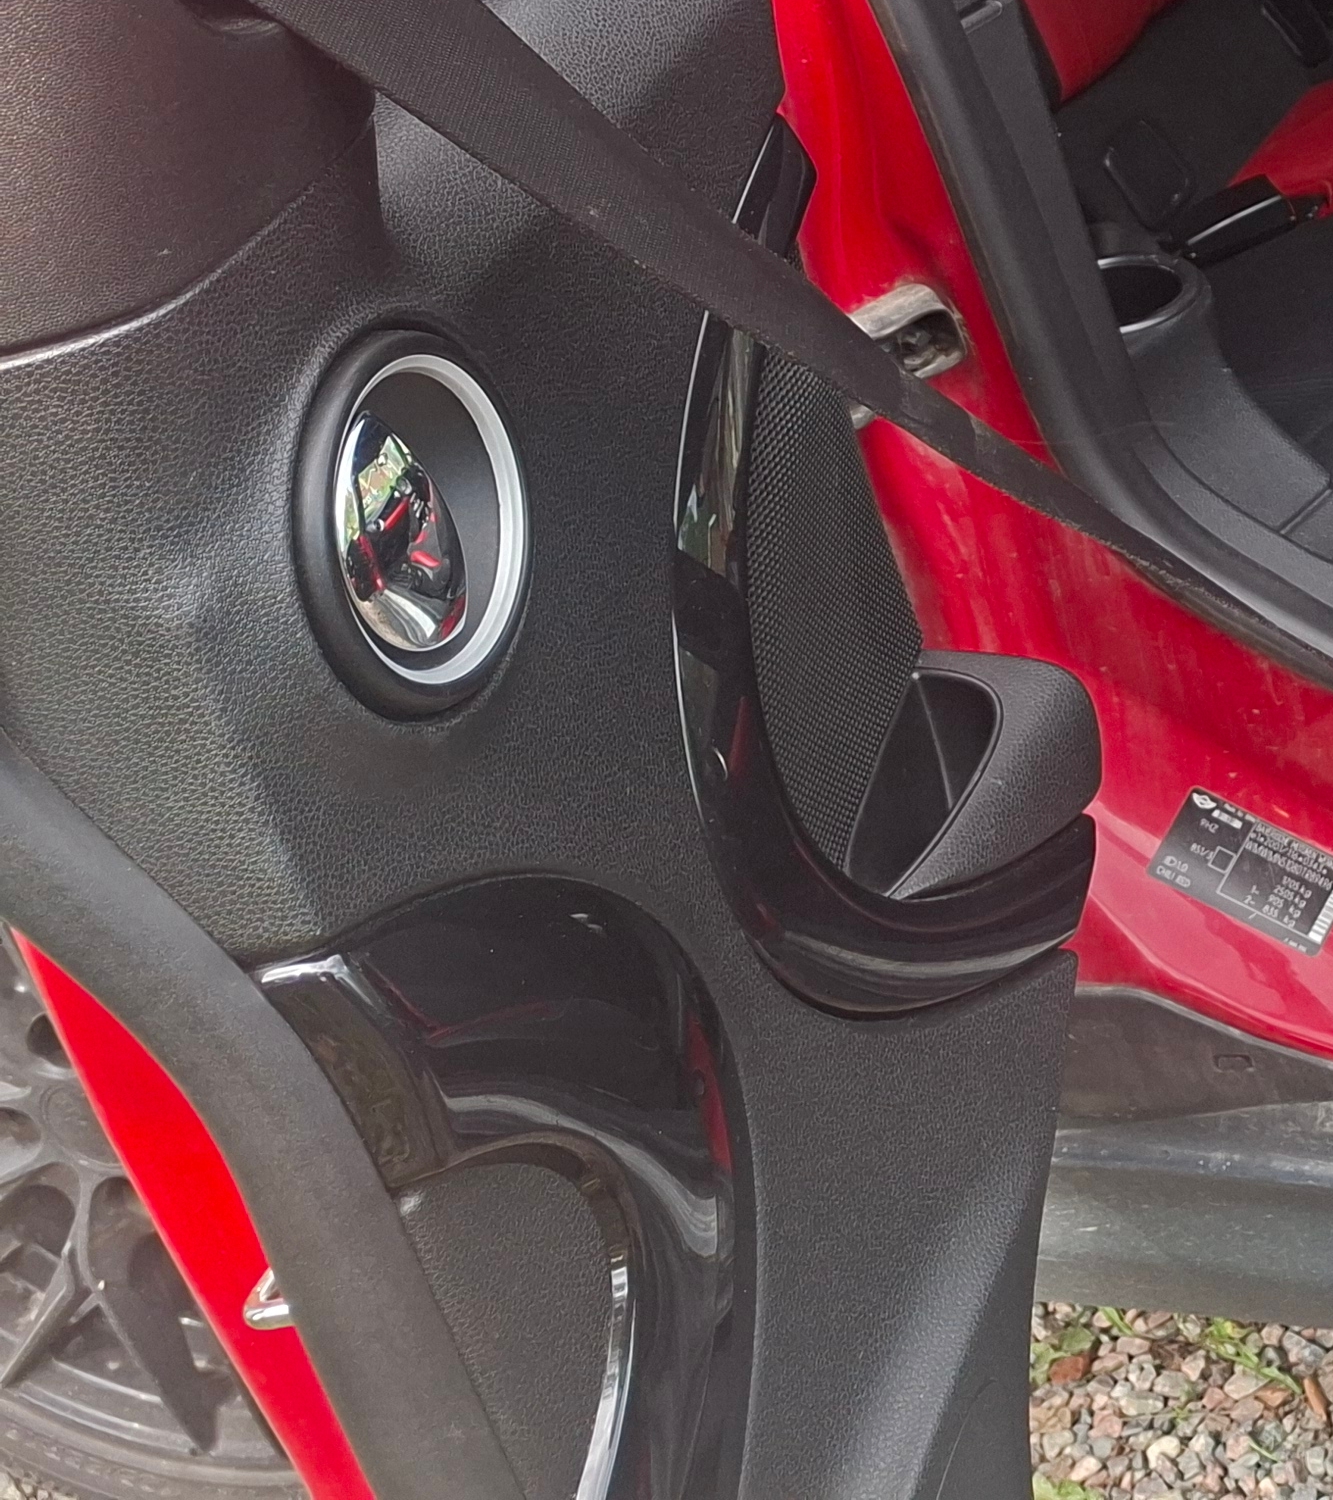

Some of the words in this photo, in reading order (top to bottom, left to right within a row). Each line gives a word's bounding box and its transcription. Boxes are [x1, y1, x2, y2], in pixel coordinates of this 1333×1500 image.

[1297, 883, 1314, 899] kg
[1291, 893, 1308, 909] kg
[1286, 904, 1302, 919] kg
[1281, 914, 1297, 928] kg
